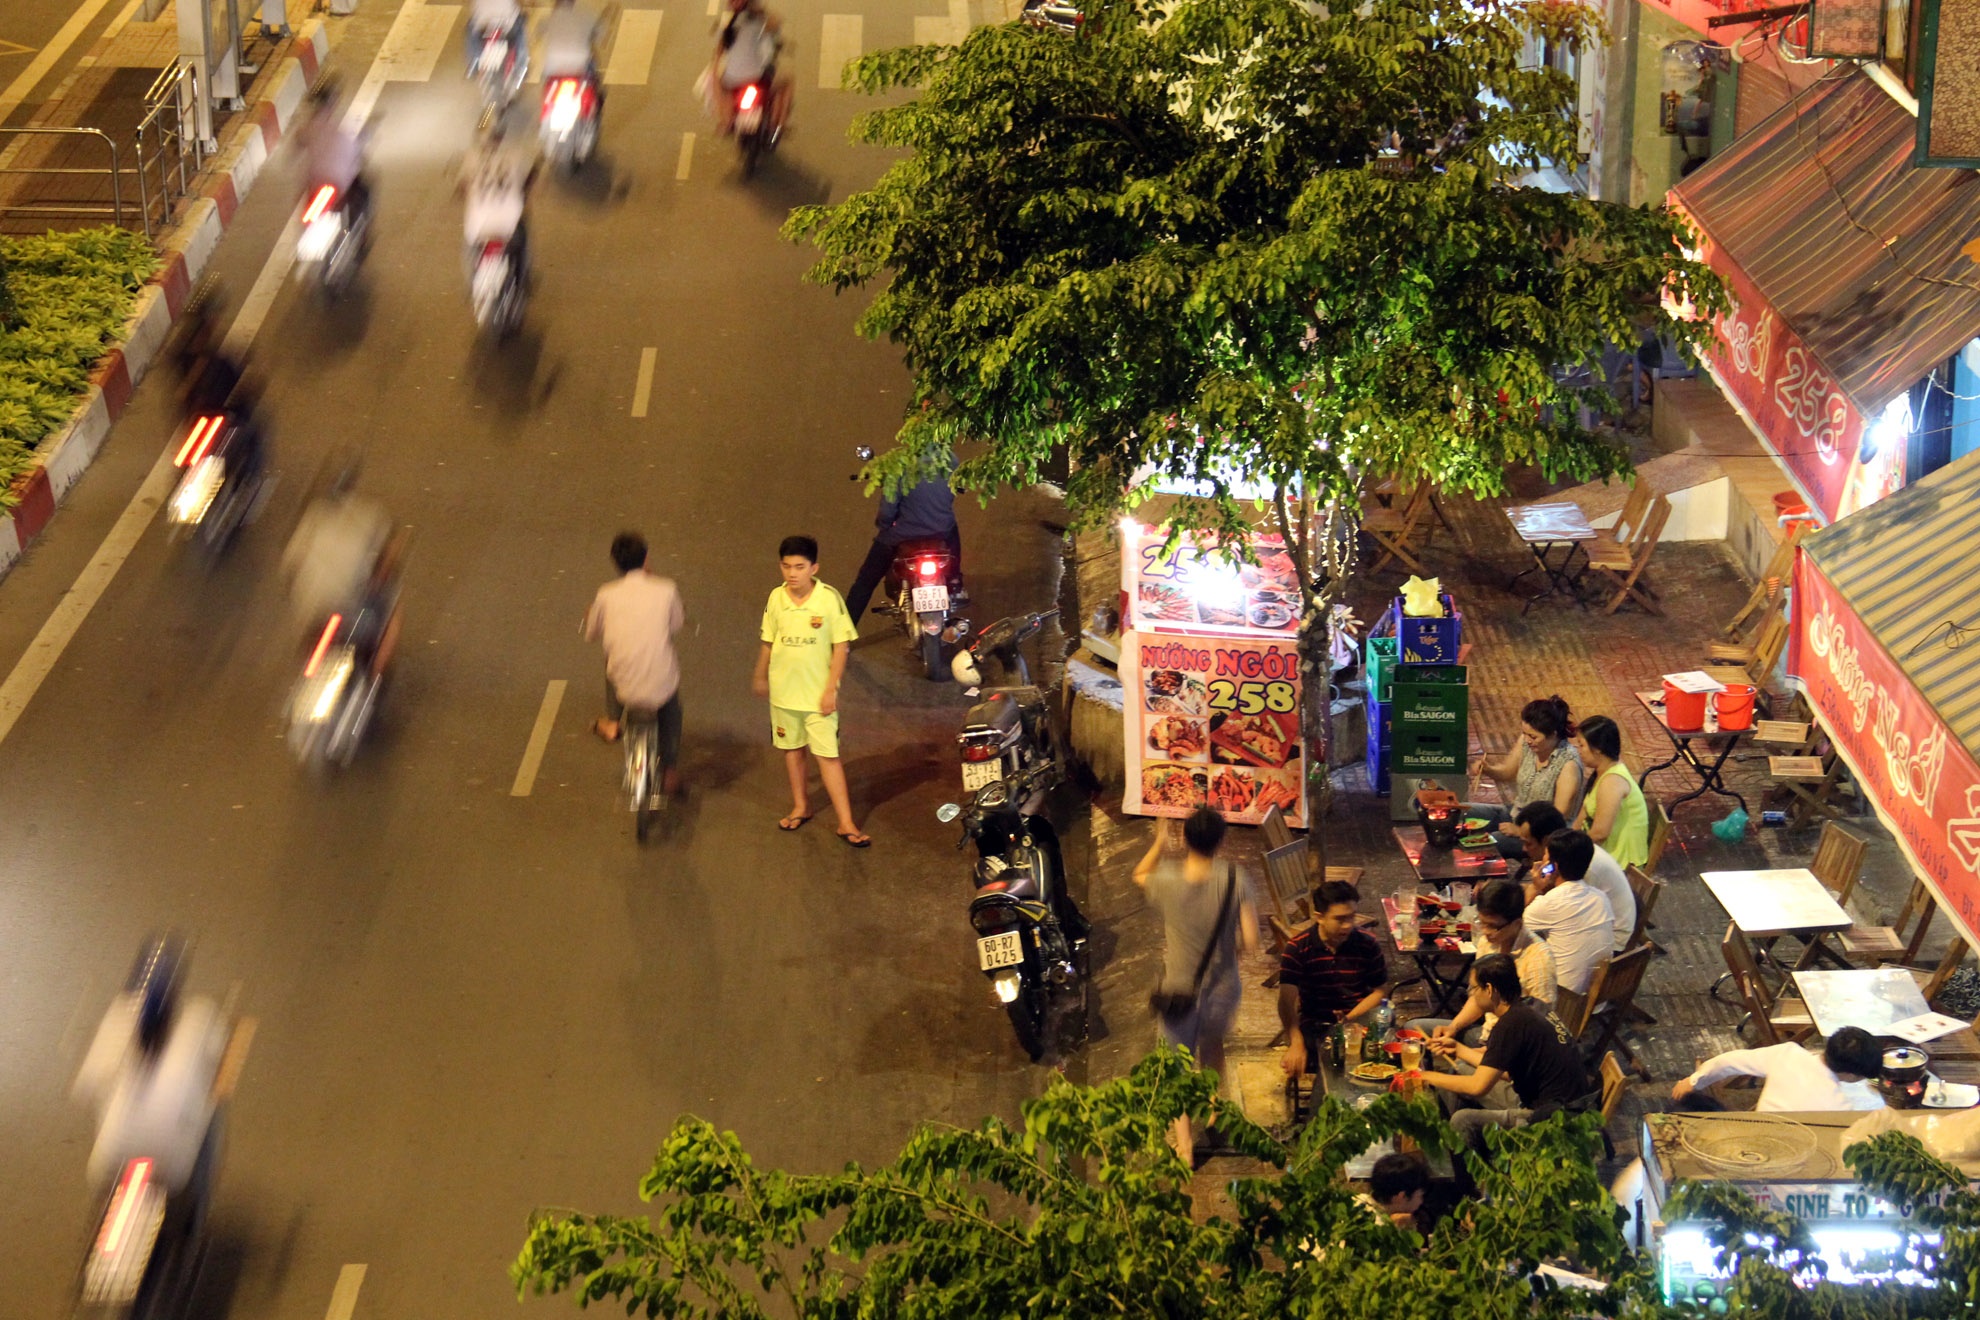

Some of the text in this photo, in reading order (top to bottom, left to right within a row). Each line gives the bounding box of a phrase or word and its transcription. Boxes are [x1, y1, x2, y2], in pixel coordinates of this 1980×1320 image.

[1774, 346, 1848, 466] 258
[1141, 642, 1298, 681] NƯỚNG NGÓI
[1208, 679, 1296, 716] 258
[984, 936, 1013, 953] 60-R7
[986, 949, 1017, 966] 0425
[1786, 1194, 1829, 1218] SINH
